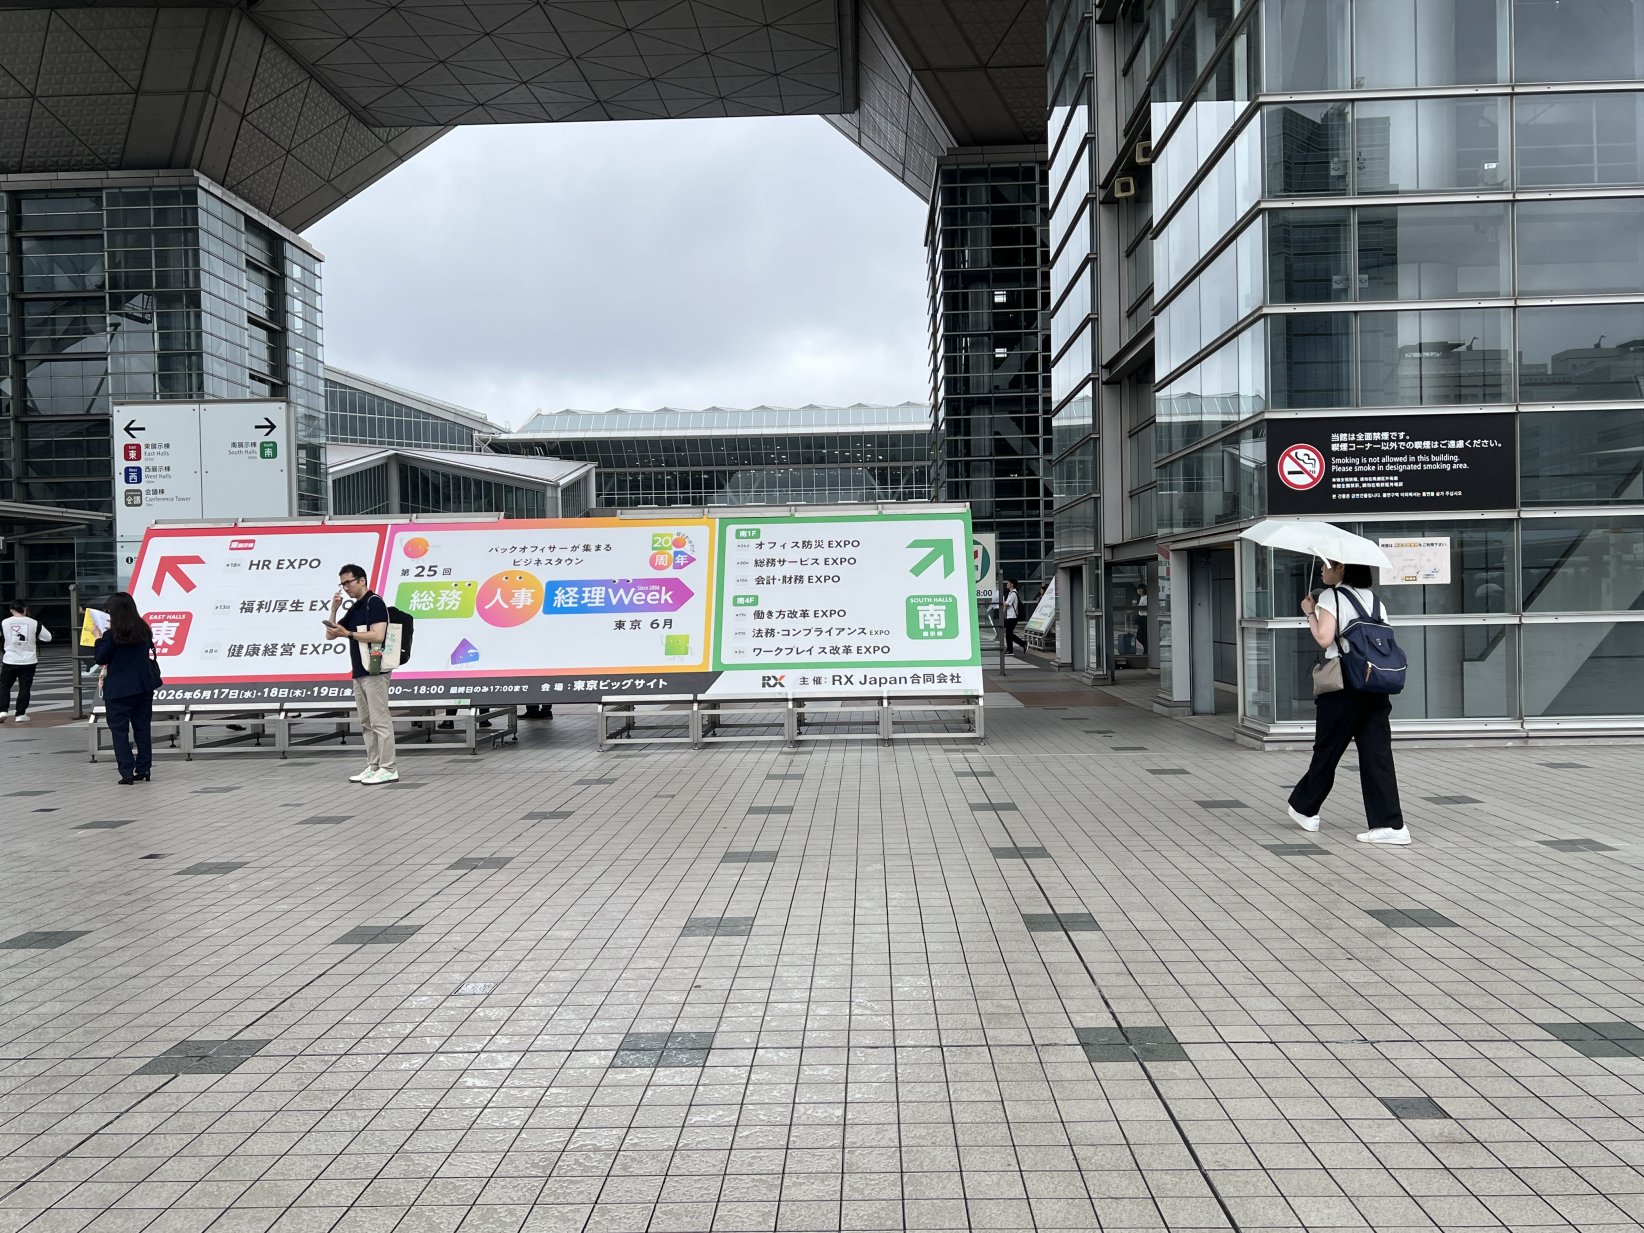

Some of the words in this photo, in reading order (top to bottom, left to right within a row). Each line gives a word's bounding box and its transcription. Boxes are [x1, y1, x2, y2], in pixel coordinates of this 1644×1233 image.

[128, 450, 137, 460] 東
[264, 448, 272, 458] 南
[1332, 457, 1359, 465] Smoking
[1431, 454, 1460, 462] building.
[1386, 463, 1421, 472] designated
[1423, 462, 1450, 471] smoking
[129, 473, 137, 482] 西
[652, 536, 671, 547] 20
[755, 540, 824, 550] オフィス防災
[828, 540, 860, 548] EXPO
[489, 544, 612, 554] バックオフィサーが集まる
[248, 559, 272, 570] HR
[276, 558, 321, 570] EXPO
[512, 558, 584, 566] ビジネスタウン
[654, 554, 688, 566] 周年
[754, 558, 820, 568] 総務サービス
[824, 557, 856, 565] EXPO
[401, 565, 452, 577] 第25回
[754, 575, 804, 585] 会計・財務
[808, 575, 841, 583] EXPO
[409, 589, 463, 611] 総務
[485, 588, 535, 609] 人事
[553, 586, 674, 608] 経理Week
[239, 599, 304, 614] 福利厚生
[309, 599, 355, 612] EXO
[753, 609, 810, 620] 働き方改革
[814, 609, 846, 618] EXPO
[917, 604, 946, 630] 南
[614, 619, 642, 630] 東京
[650, 619, 673, 630] 6月
[151, 621, 180, 646] 東
[752, 627, 867, 638] 法務・コンプライアンス
[227, 643, 296, 658] 健康経営
[300, 643, 346, 655] EXPO
[753, 645, 853, 656] ワークプレイス改革
[856, 645, 891, 654] EXPO
[762, 675, 785, 688] RX
[832, 674, 854, 686] RX
[858, 672, 962, 688] Japan合同会社
